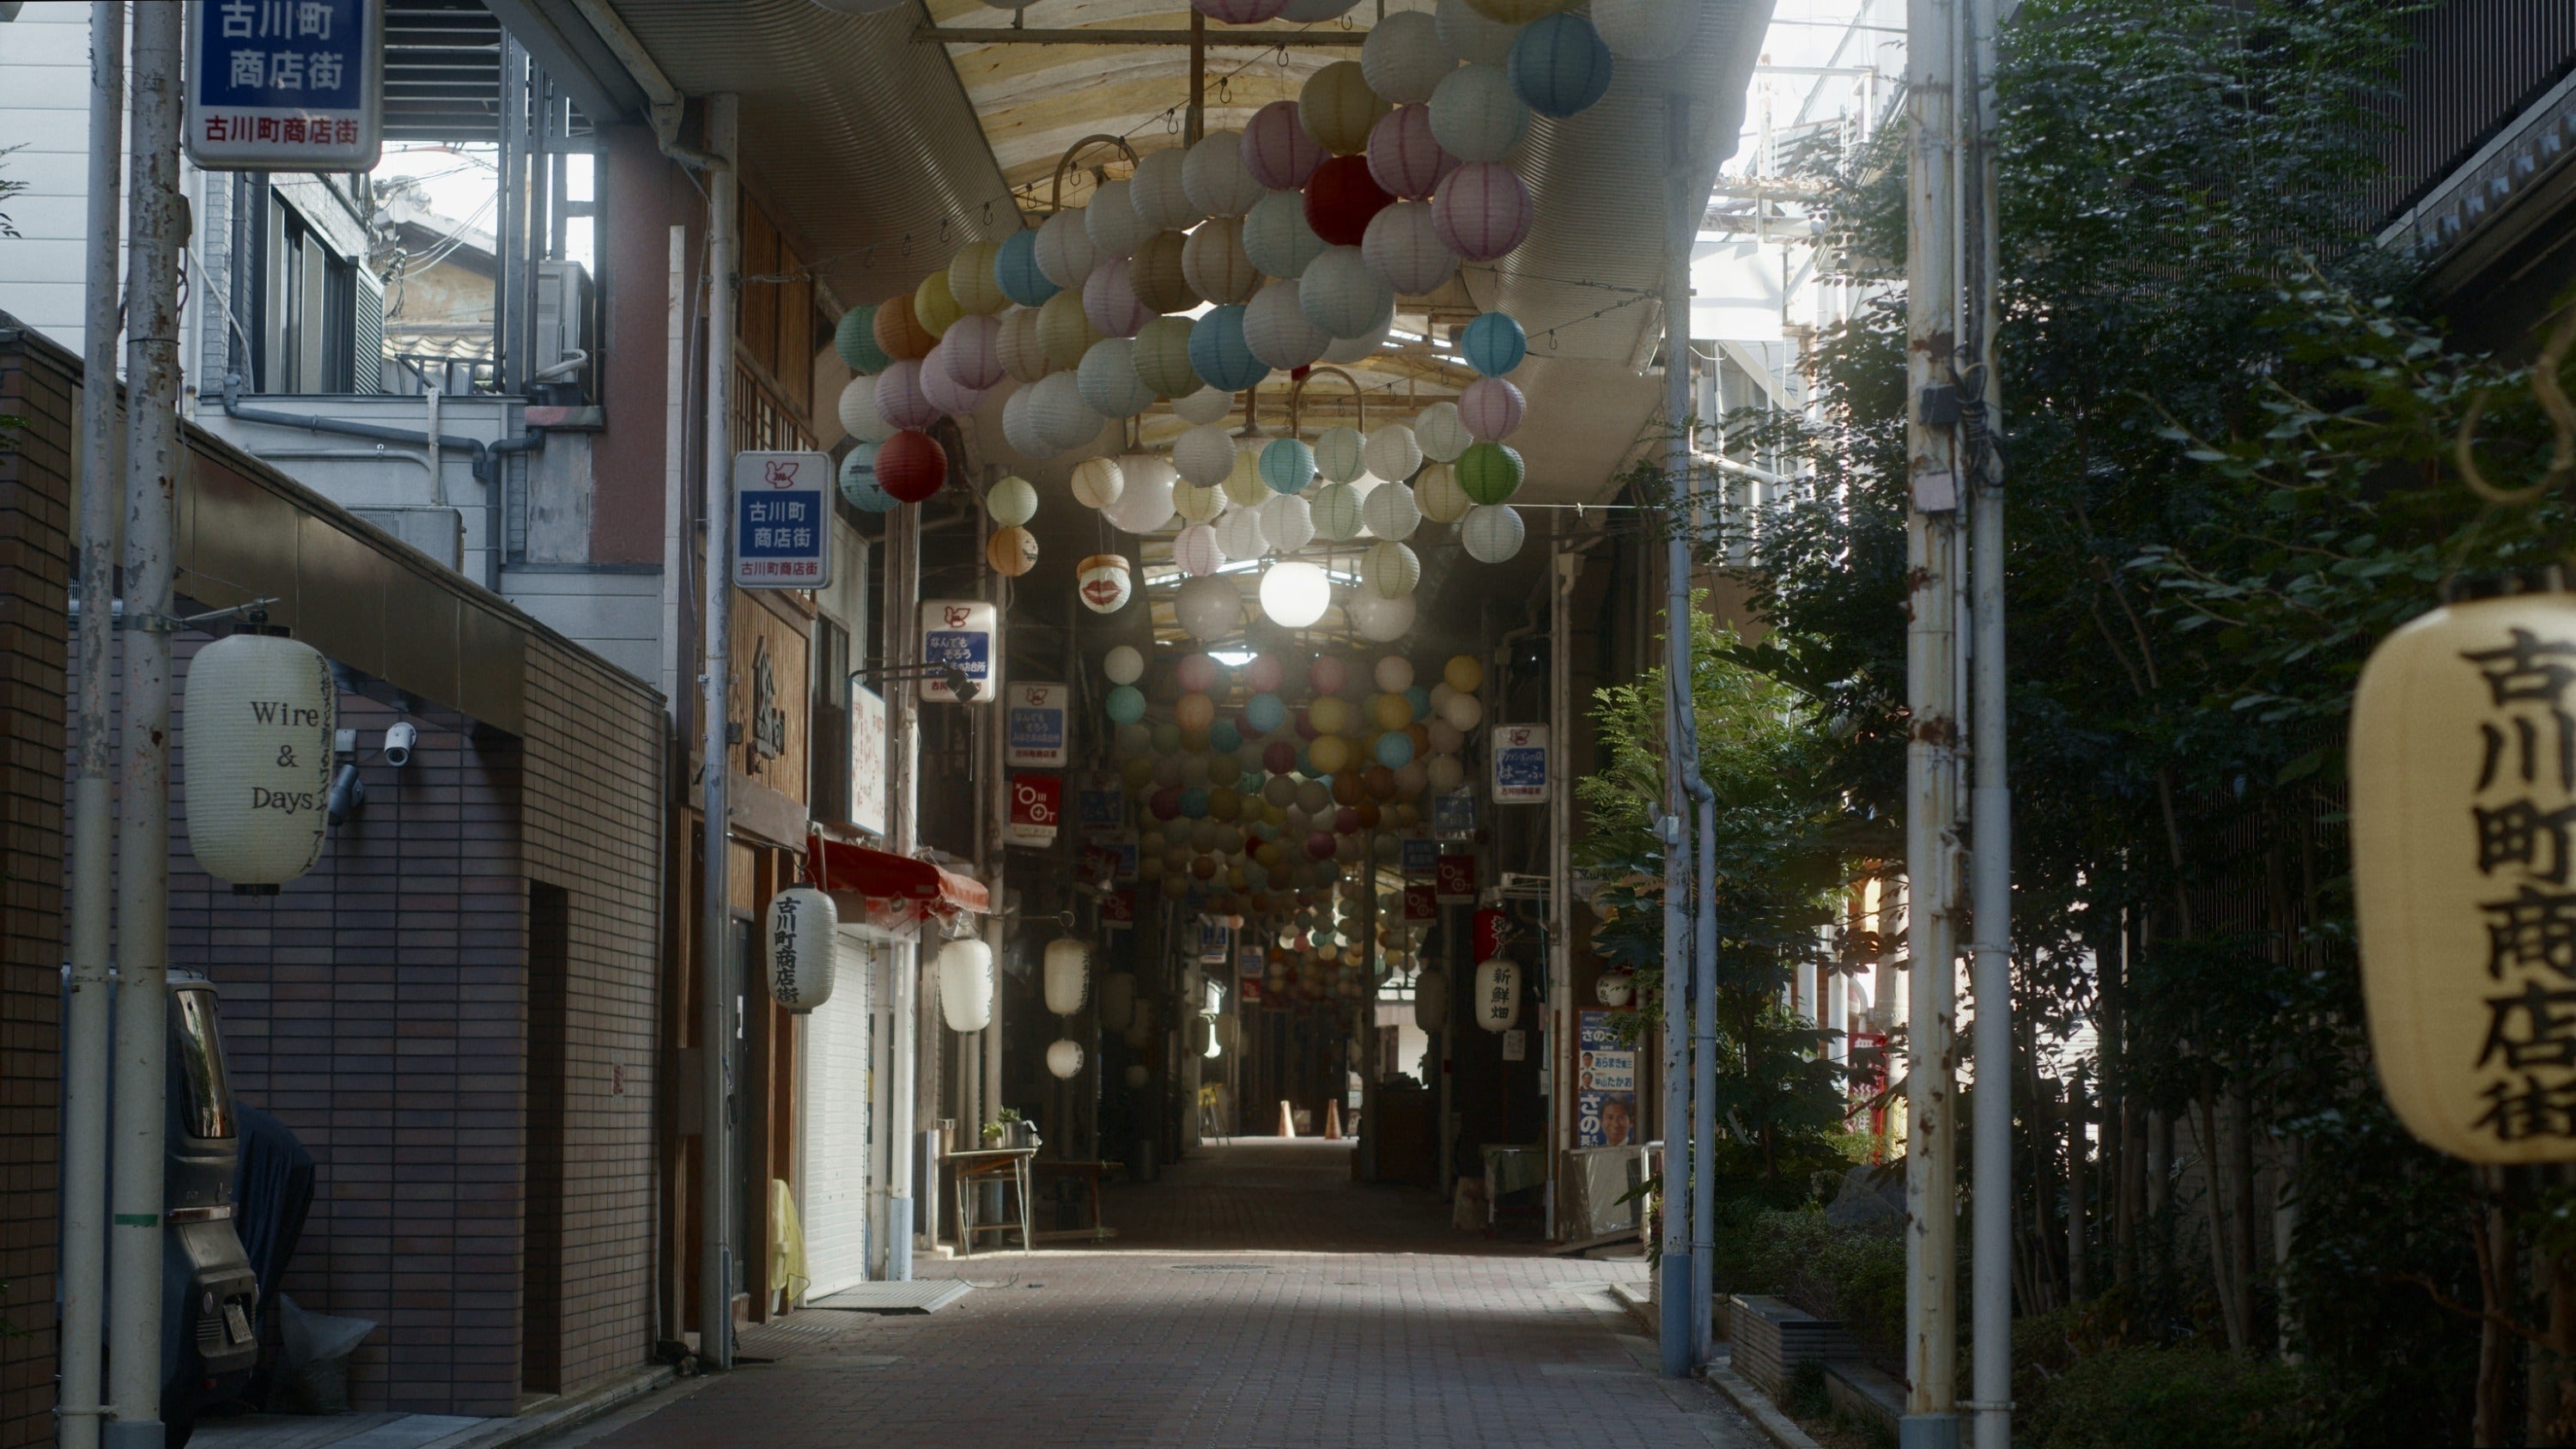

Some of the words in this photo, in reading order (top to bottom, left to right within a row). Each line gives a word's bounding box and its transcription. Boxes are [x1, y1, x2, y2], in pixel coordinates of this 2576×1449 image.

[221, 1, 333, 40] 古川町
[229, 48, 343, 90] 商店街
[205, 115, 358, 145] 古川町商店街
[749, 501, 805, 522] 古川町
[755, 527, 811, 548] 商店街
[741, 562, 817, 576] 古川町商店街
[930, 636, 967, 648] なんでも
[944, 648, 972, 660] そろう
[250, 701, 319, 727] Wire
[276, 745, 299, 768] &
[252, 786, 313, 814] Days
[2458, 626, 2576, 1144] 古川町商店街
[774, 897, 801, 1004] 古川町商店街
[1491, 967, 1512, 1020] 新鮮畑
